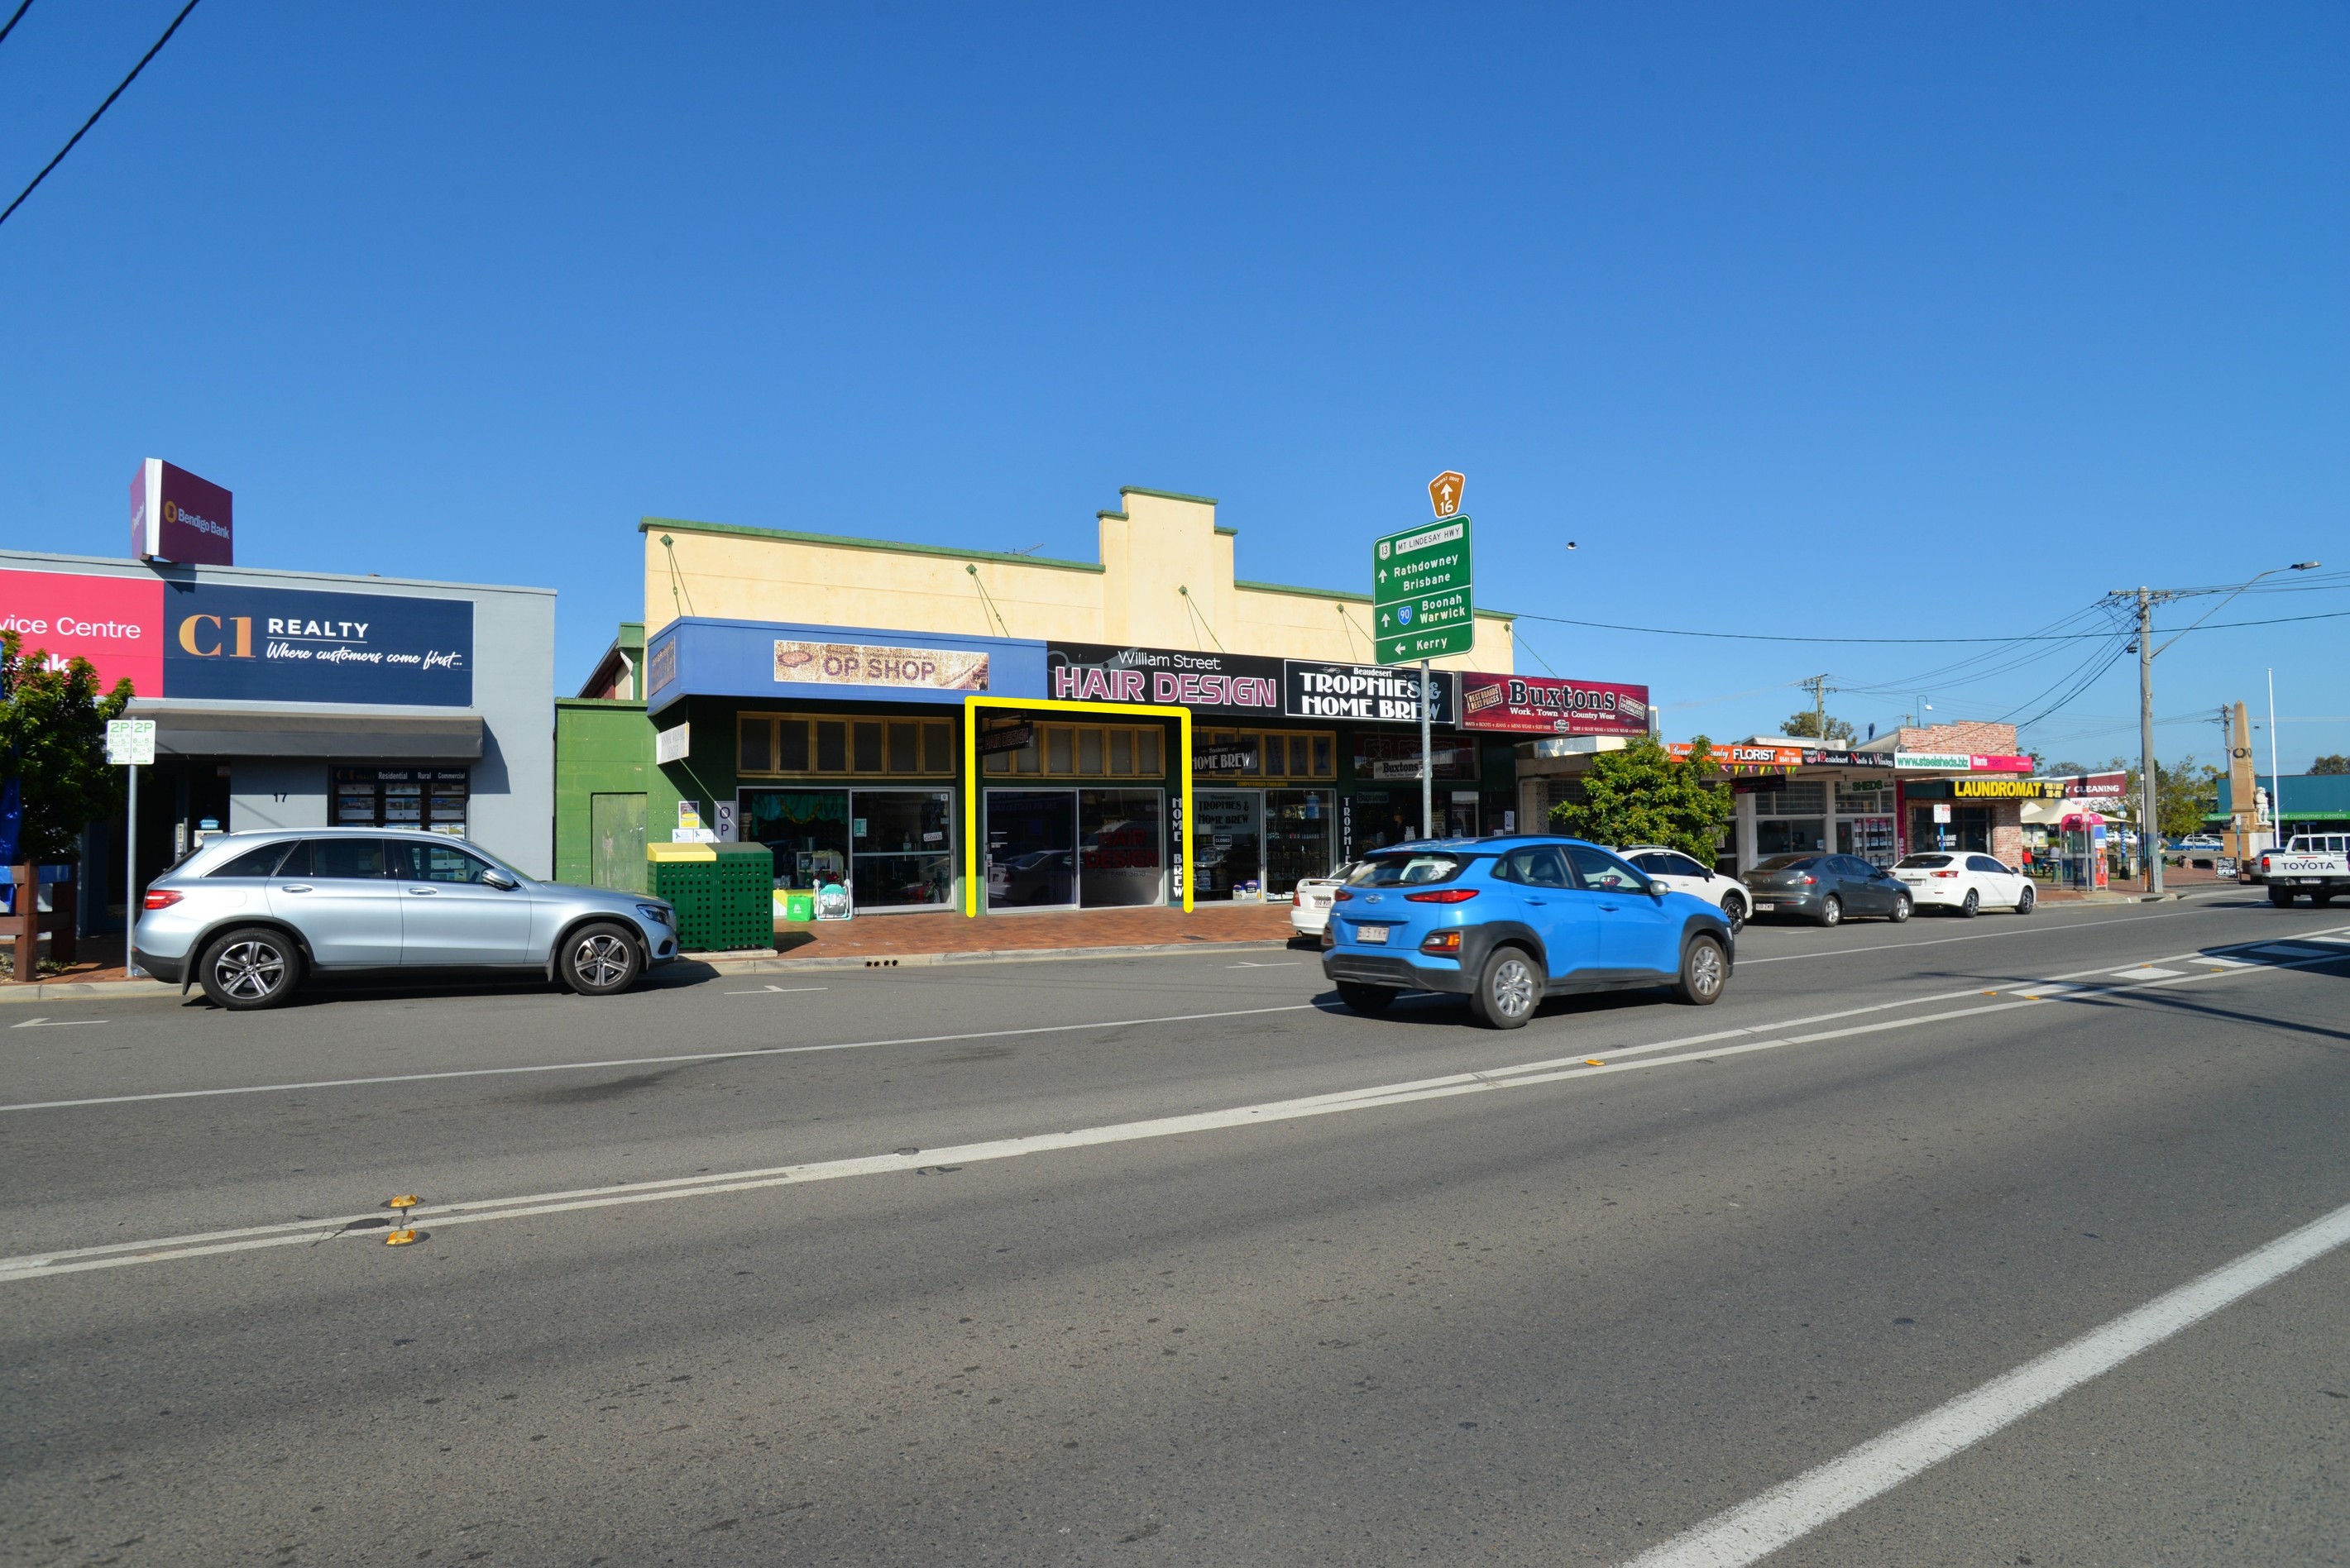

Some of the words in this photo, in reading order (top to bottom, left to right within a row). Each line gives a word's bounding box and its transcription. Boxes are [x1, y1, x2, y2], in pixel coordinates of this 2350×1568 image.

[1433, 476, 1448, 488] TOURIST
[1440, 500, 1453, 514] 16
[178, 508, 210, 533] Bendigo
[210, 521, 230, 539] Bank
[1398, 542, 1406, 552] MT
[1409, 533, 1441, 548] LINDESAY
[1444, 527, 1460, 538] HWY
[1381, 545, 1388, 556] 13
[1394, 554, 1458, 577] Rathdowney
[1403, 573, 1451, 591] Brisbane
[1422, 594, 1462, 611] Boonah
[1400, 609, 1410, 619] 90
[1419, 607, 1465, 624] Warwick
[56, 617, 141, 639] Centre
[179, 614, 256, 657] C1
[268, 618, 369, 638] REALTY
[1416, 638, 1448, 651] Kerry
[266, 641, 313, 660] Where
[316, 646, 383, 664] customers
[387, 653, 421, 664] come
[1118, 650, 1170, 667] William
[1173, 654, 1221, 670] Street
[823, 656, 859, 676] OP
[868, 658, 936, 681] SHOP
[1353, 667, 1392, 677] Beaudesert
[1055, 666, 1145, 701] HAIR
[1153, 672, 1276, 707] DESIGN
[1299, 672, 1419, 699] TROPHIES
[1429, 681, 1442, 700] &
[1468, 692, 1481, 702] BEST
[1508, 679, 1615, 710] Buxtons
[1302, 696, 1374, 717] HOME
[1379, 700, 1441, 720] BREW
[1471, 700, 1483, 710] BEST
[1510, 707, 1534, 717] Work,
[1536, 709, 1558, 717] Town
[1572, 710, 1597, 720] Country
[1598, 712, 1615, 720] Wear
[110, 722, 130, 733] 2P
[134, 722, 153, 733] 2P
[985, 733, 1001, 749] HAIR
[1002, 728, 1029, 747] DESIGN
[1220, 752, 1251, 767] BREW
[1733, 748, 1777, 761] FLORIST
[1821, 750, 1849, 763] Beaudesert
[1850, 752, 1868, 764] Nails
[1897, 755, 1969, 768] www.steelsheds.biz
[1382, 761, 1419, 773] Buxtons
[378, 771, 408, 780] Residential
[418, 772, 431, 780] Rural
[1852, 780, 1883, 791] SHEDS
[1955, 781, 2041, 796] LAUNDROMAT
[2074, 785, 2119, 793] CLEANING
[273, 792, 287, 802] 17
[1198, 801, 1242, 810] TROPHIES
[1243, 801, 1250, 810] &
[1172, 797, 1182, 842] HOME
[1198, 813, 1223, 825] HOME
[1225, 814, 1250, 825] BREW
[1098, 829, 1146, 847] HAIR
[1343, 797, 1352, 864] TROPHIE
[1084, 849, 1160, 868] DESIGN
[2281, 862, 2336, 870] TOYOTA
[1173, 853, 1184, 897] BREW
